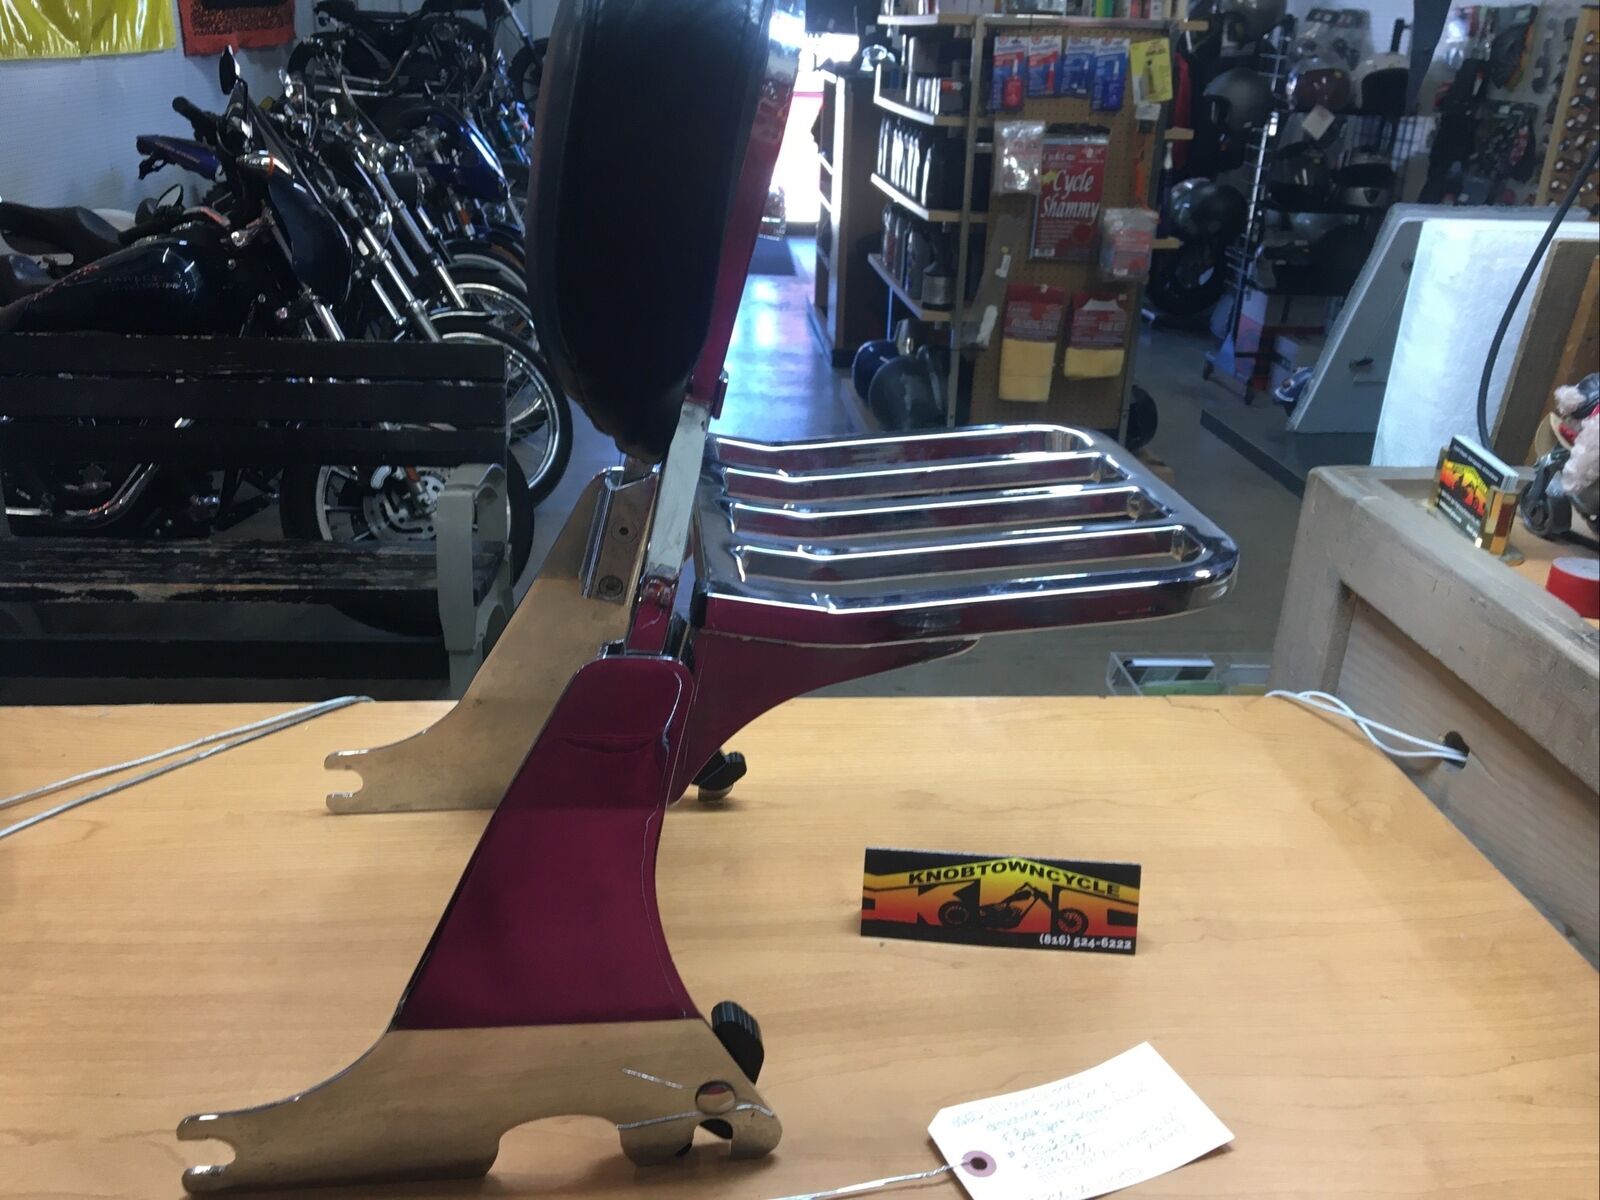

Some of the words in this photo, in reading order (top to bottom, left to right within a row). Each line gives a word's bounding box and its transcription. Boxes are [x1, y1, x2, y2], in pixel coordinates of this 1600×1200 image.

[1052, 167, 1095, 200] Cycle
[1040, 193, 1100, 225] Shammy
[908, 860, 1120, 898] KNOBTOWNCYCLE
[1039, 932, 1071, 947] (816)
[1073, 935, 1132, 950] 524-6222
